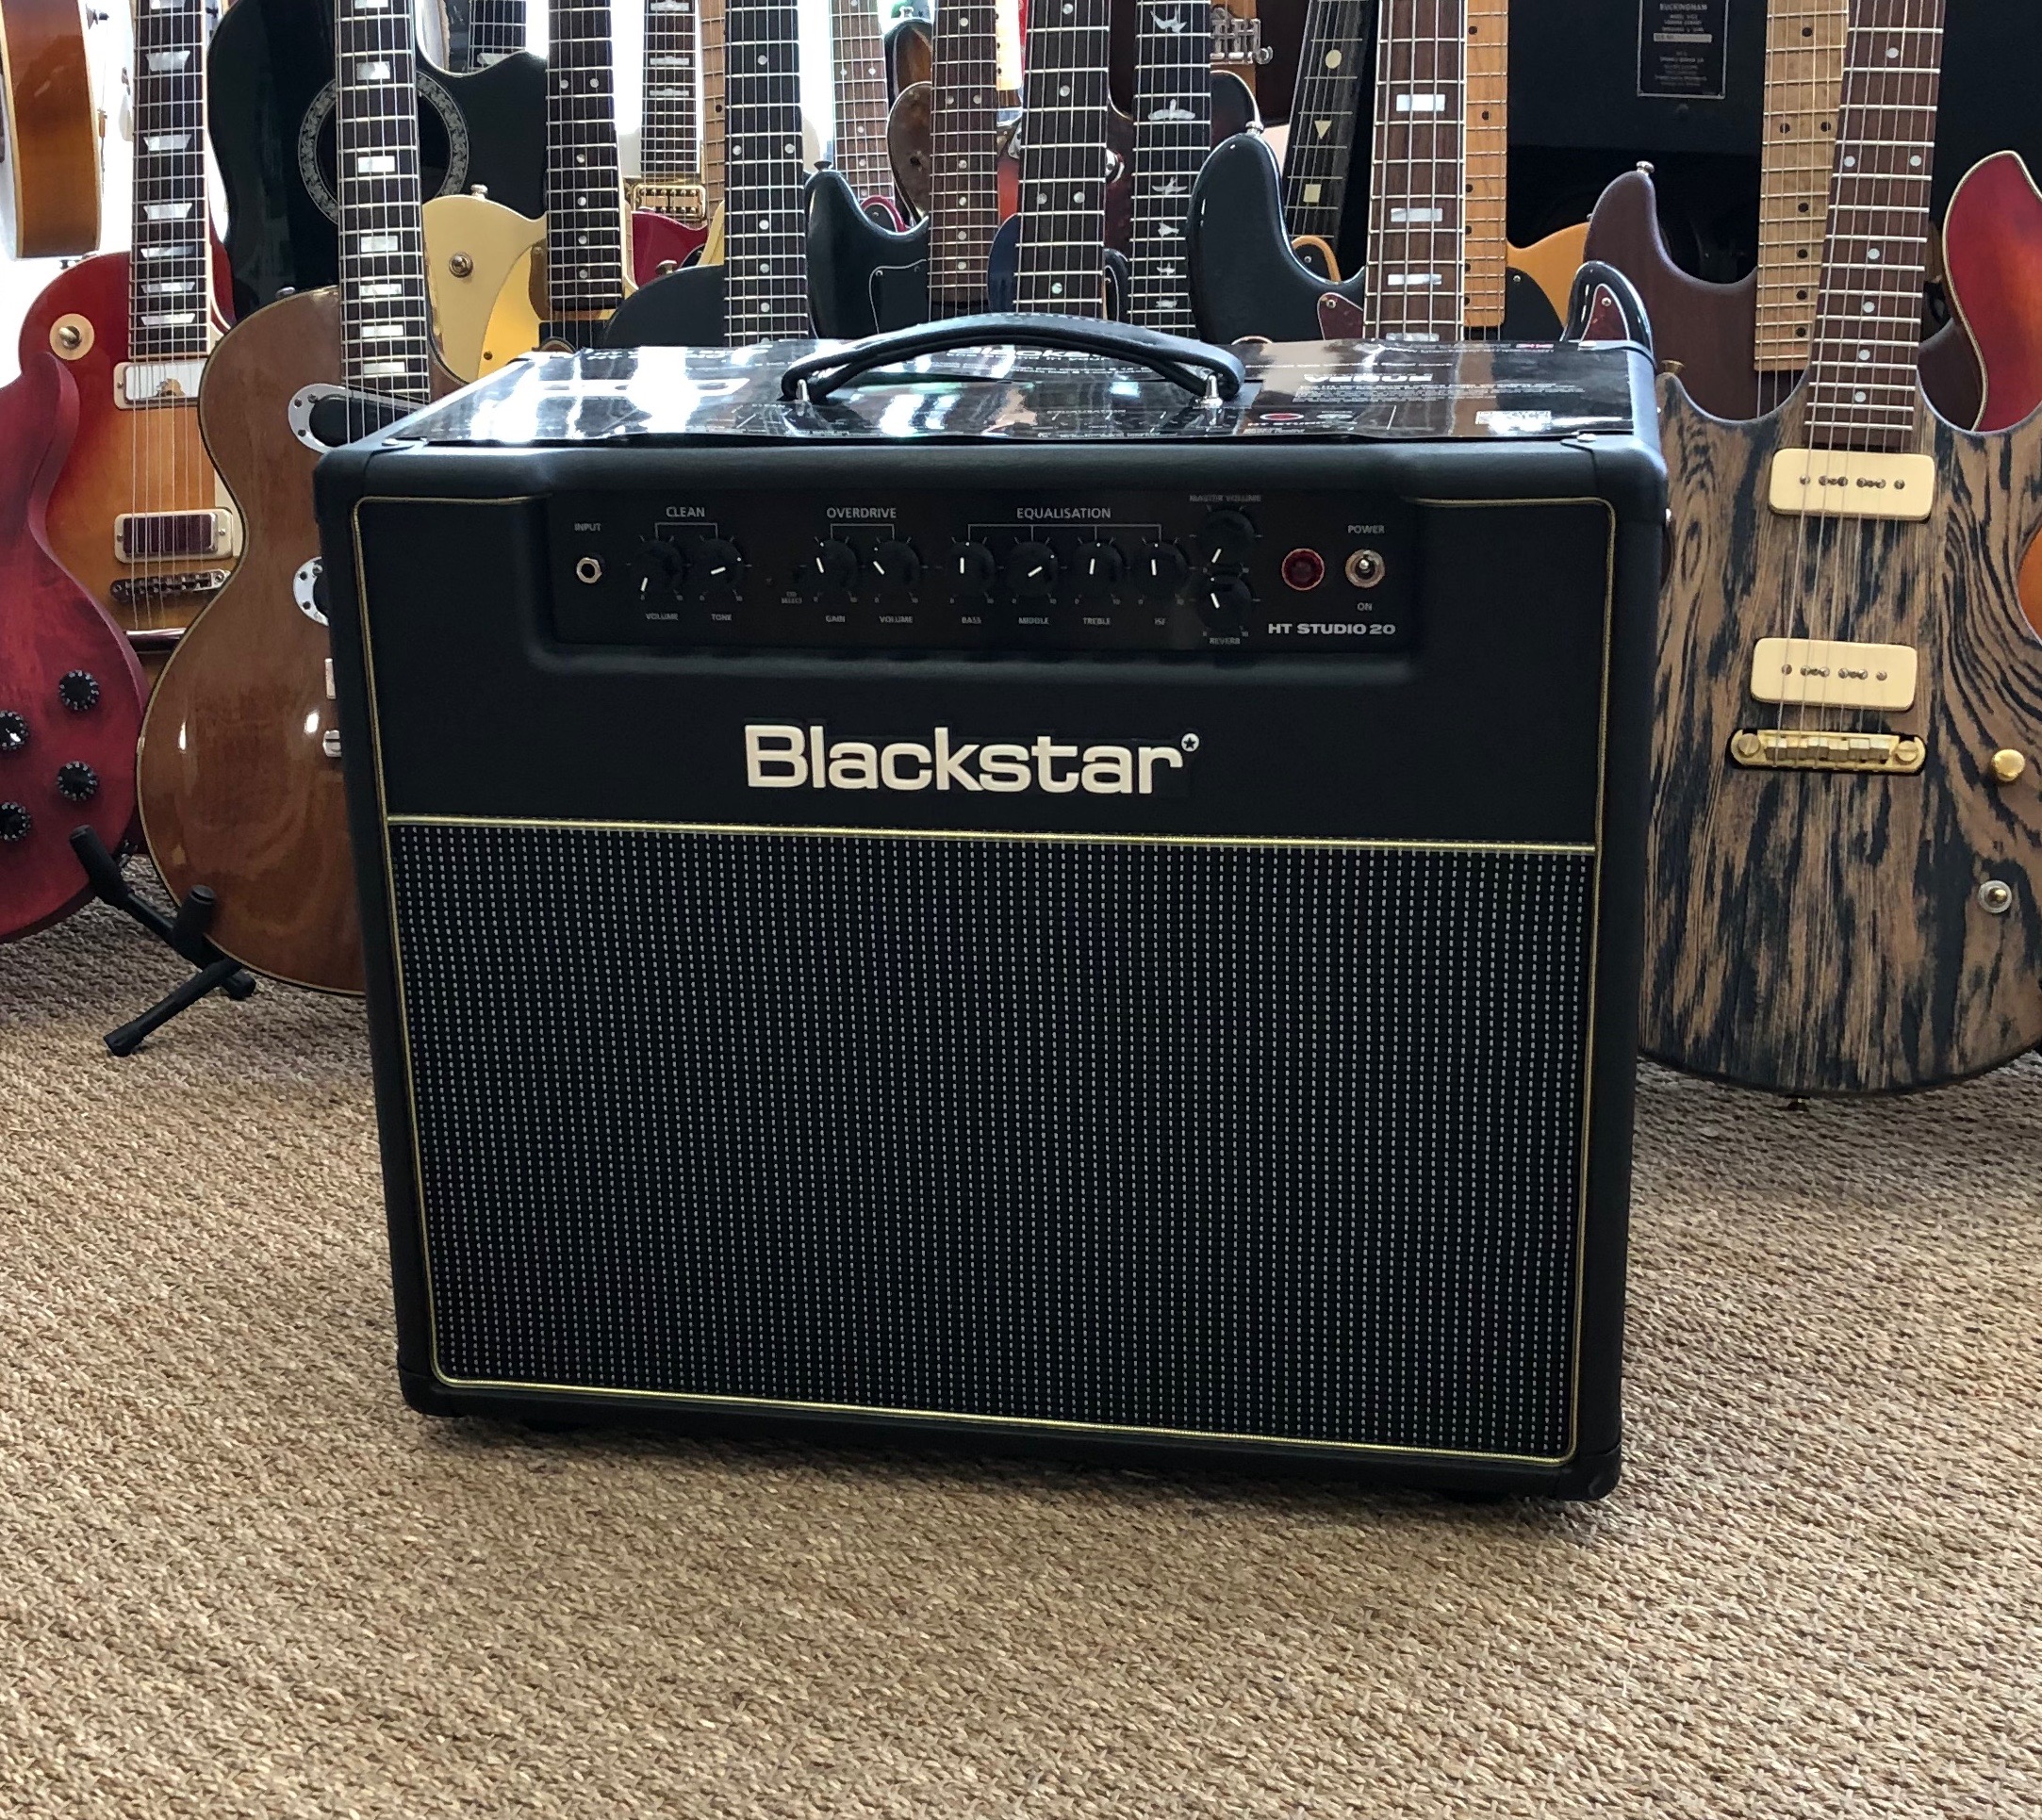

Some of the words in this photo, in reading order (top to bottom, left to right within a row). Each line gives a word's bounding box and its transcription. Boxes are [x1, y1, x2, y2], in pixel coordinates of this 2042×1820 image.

[666, 506, 706, 517] CLEAN
[826, 507, 897, 519] OVERDRIVE
[1016, 507, 1112, 520] EQUALISATION
[574, 522, 602, 533] INPUT
[1347, 524, 1386, 534] POWER
[1357, 601, 1373, 612] ON
[1268, 622, 1293, 635] HT
[1296, 622, 1366, 635] STUDIO
[1369, 623, 1396, 635] 20
[745, 724, 1184, 795] Blackstar
